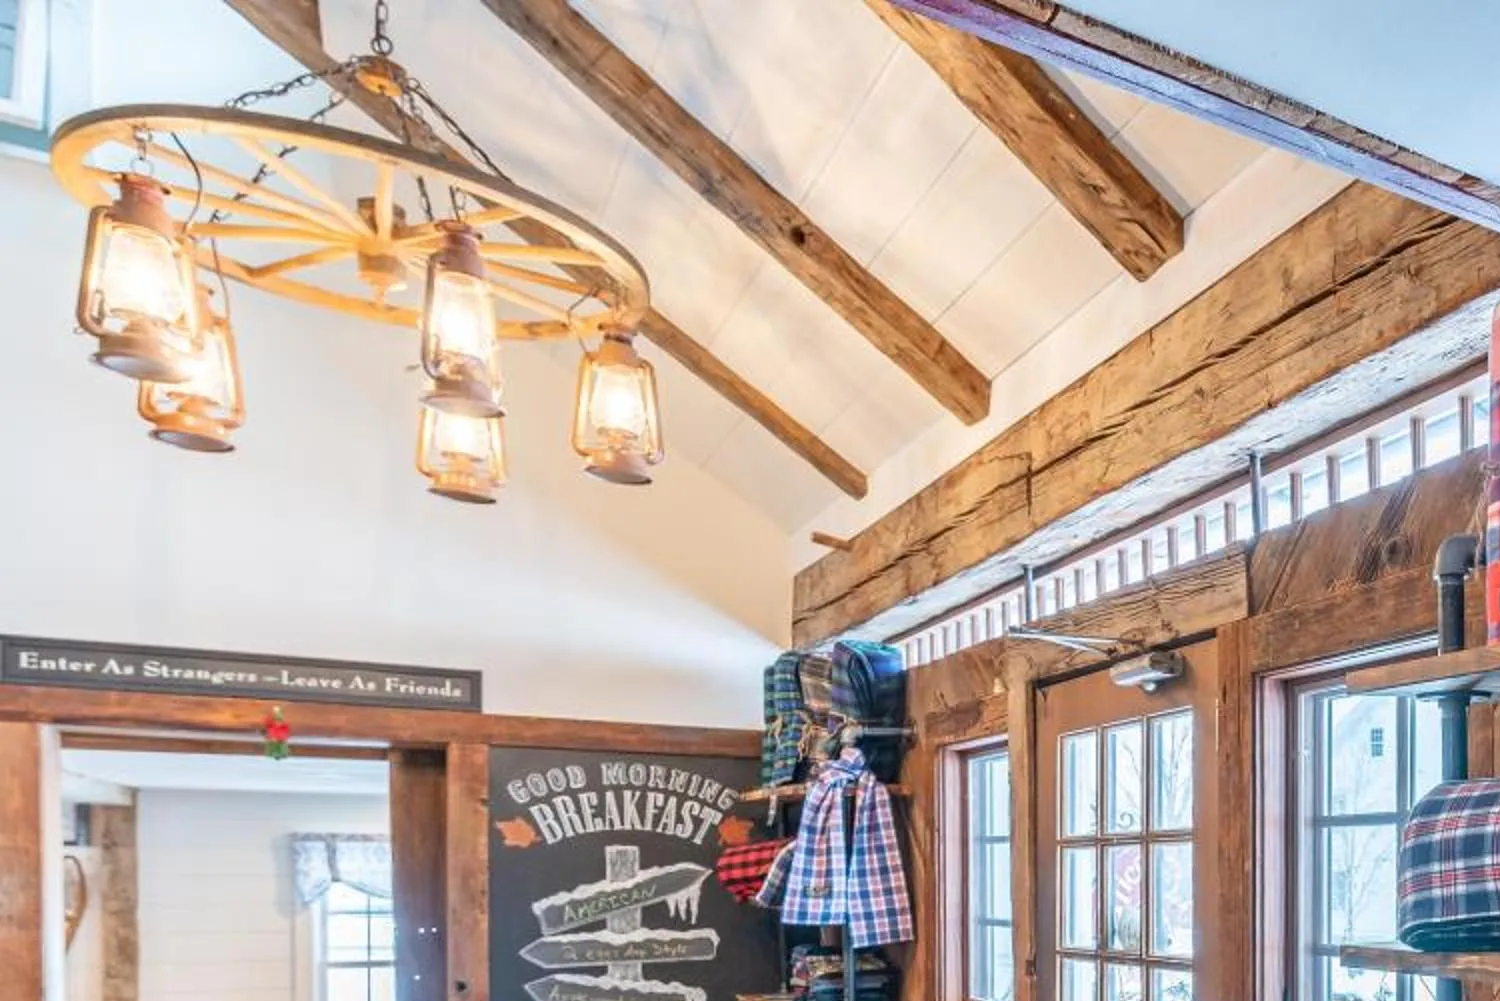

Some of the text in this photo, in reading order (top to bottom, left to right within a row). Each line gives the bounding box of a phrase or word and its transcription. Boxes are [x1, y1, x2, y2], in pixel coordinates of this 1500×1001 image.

[18, 651, 97, 673] Enter
[101, 657, 135, 676] As
[143, 660, 257, 685] Strangers
[349, 675, 378, 692] As
[384, 677, 463, 698] Friends
[507, 761, 740, 810] GOOD MORNING
[528, 789, 725, 845] BREAKFAST
